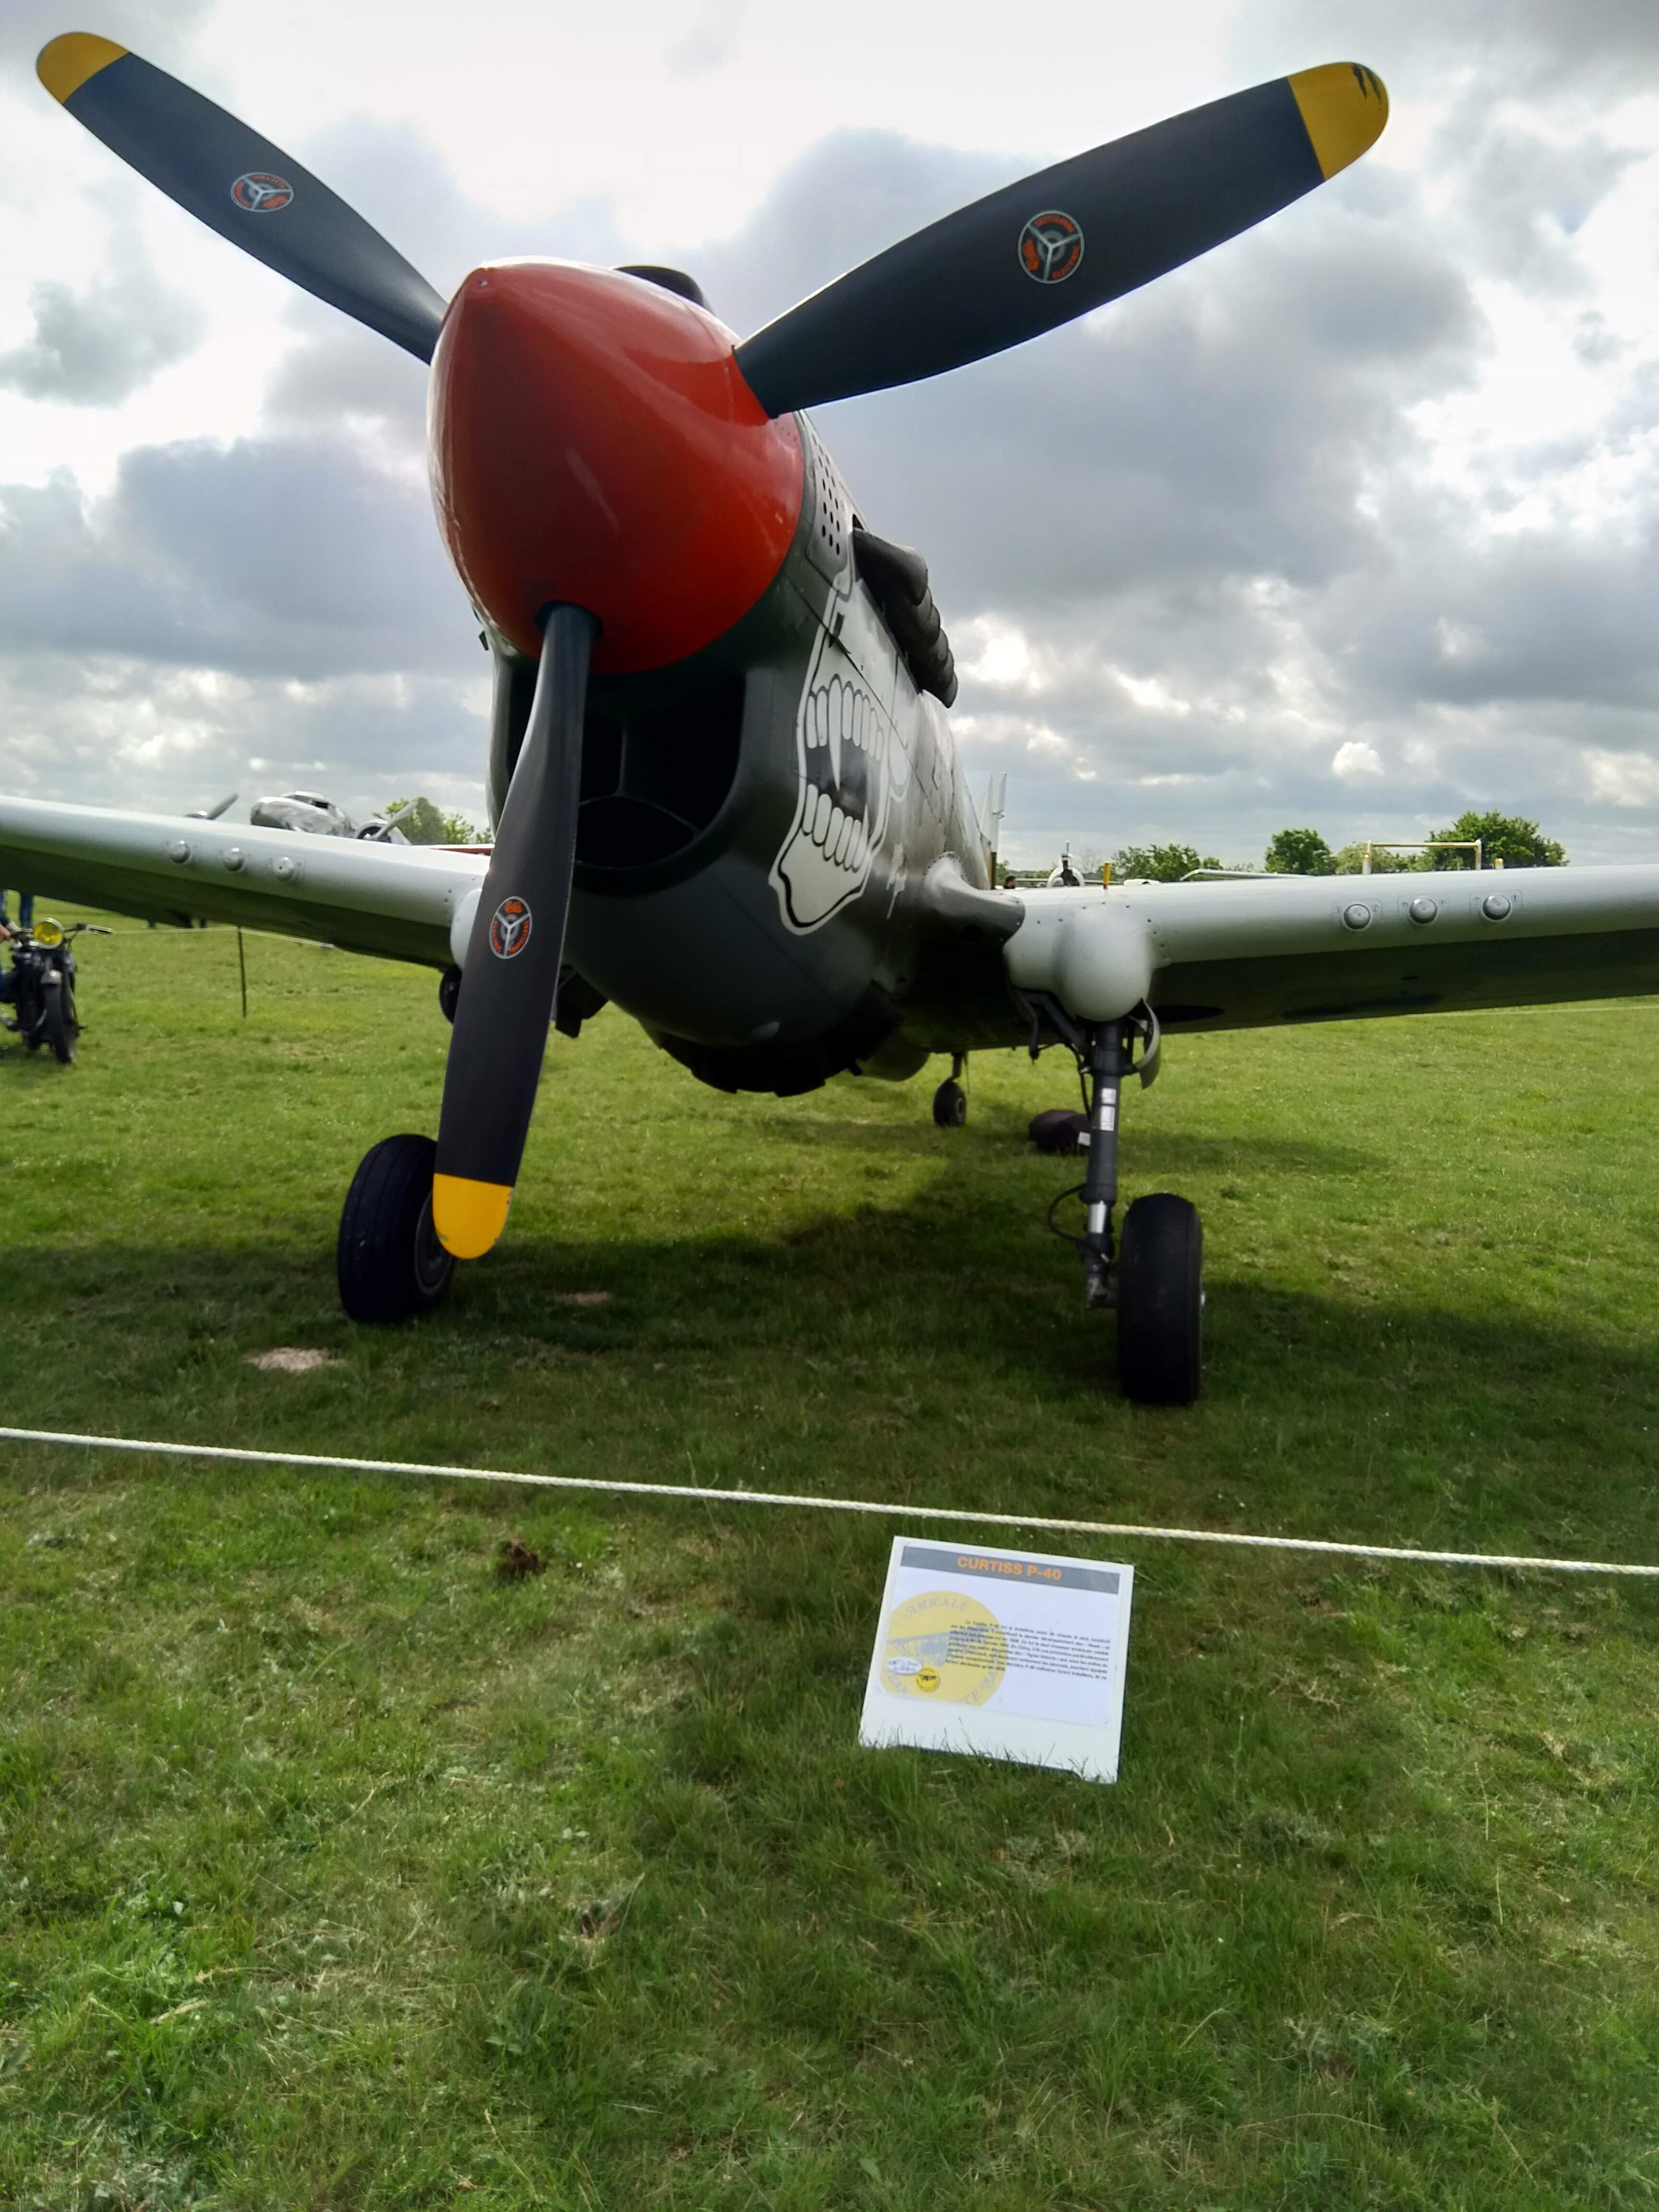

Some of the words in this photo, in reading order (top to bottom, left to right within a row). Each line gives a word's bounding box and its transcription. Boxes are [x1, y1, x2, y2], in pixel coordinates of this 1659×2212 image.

[957, 1556, 1023, 1575] CURTISS
[1026, 1564, 1061, 1580] P-40
[903, 1597, 969, 1620] AMICALE
